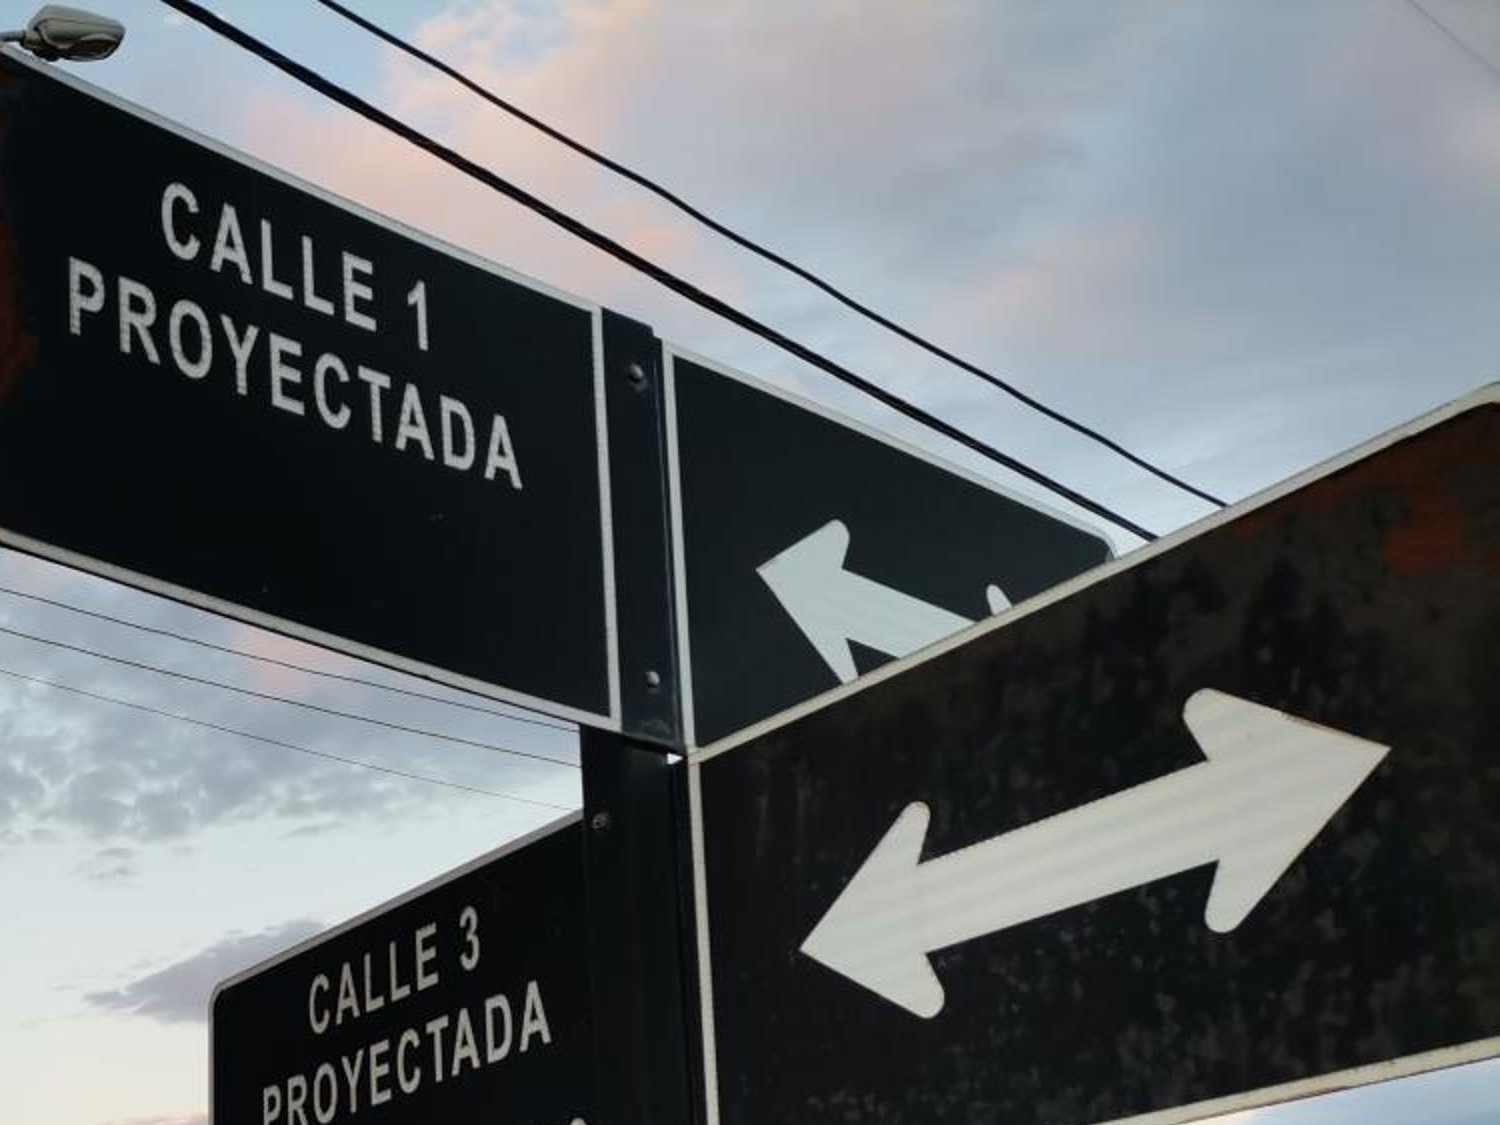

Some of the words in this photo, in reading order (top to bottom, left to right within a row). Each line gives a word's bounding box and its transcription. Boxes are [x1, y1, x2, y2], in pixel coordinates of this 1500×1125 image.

[161, 182, 377, 333] CALLE
[407, 280, 429, 352] 1
[68, 256, 524, 491] PROYECTADA
[309, 922, 440, 1036] CALLE
[458, 905, 481, 972] 3
